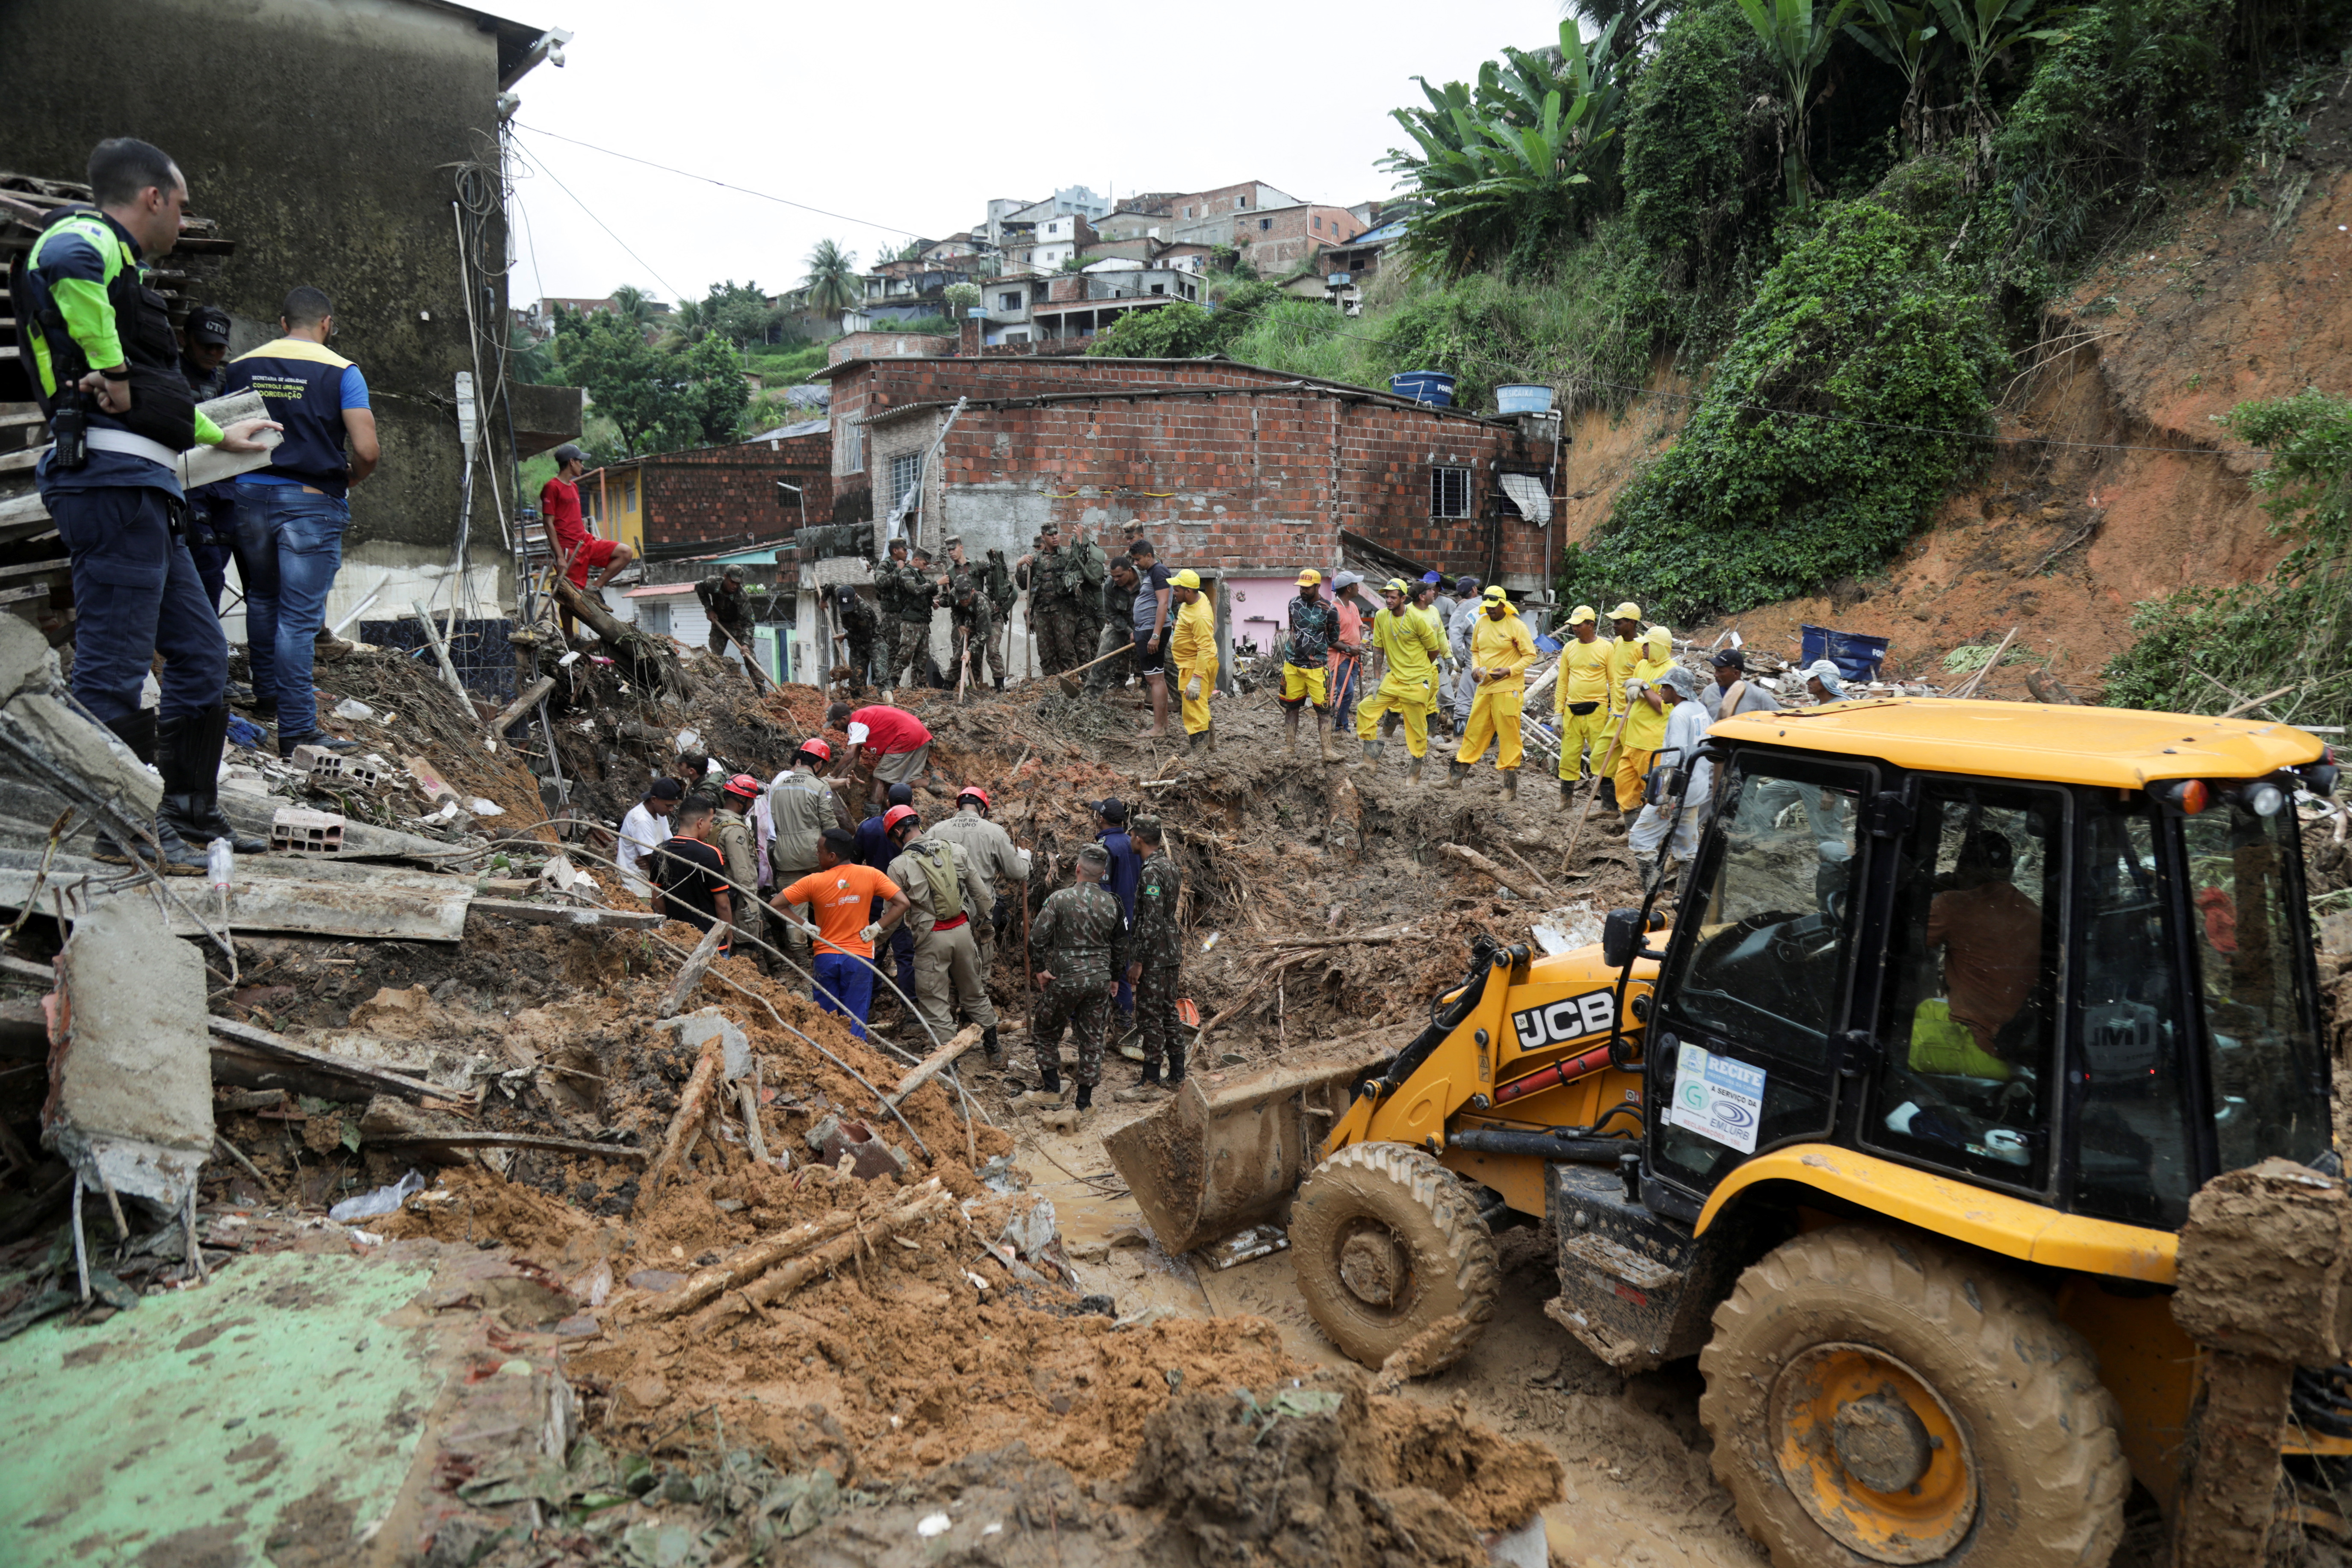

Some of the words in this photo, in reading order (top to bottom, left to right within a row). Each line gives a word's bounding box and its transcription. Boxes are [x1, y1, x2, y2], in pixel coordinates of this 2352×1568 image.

[206, 321, 226, 334] GTO
[258, 390, 302, 400] OORDENAÇÃO
[1501, 389, 1533, 398] RESICAIXA
[1519, 992, 1615, 1048] JCB
[1708, 1056, 1763, 1087] RECIFE
[1707, 1072, 1735, 1086] PREFEITURA
[1743, 1084, 1761, 1096] CIDADE
[1717, 1087, 1746, 1103] SERVIÇO
[1748, 1096, 1757, 1107] DA
[1683, 1119, 1726, 1141] RECLAMAÇÕES
[1730, 1138, 1741, 1147] 156
[1710, 1118, 1750, 1141] EMLURB
